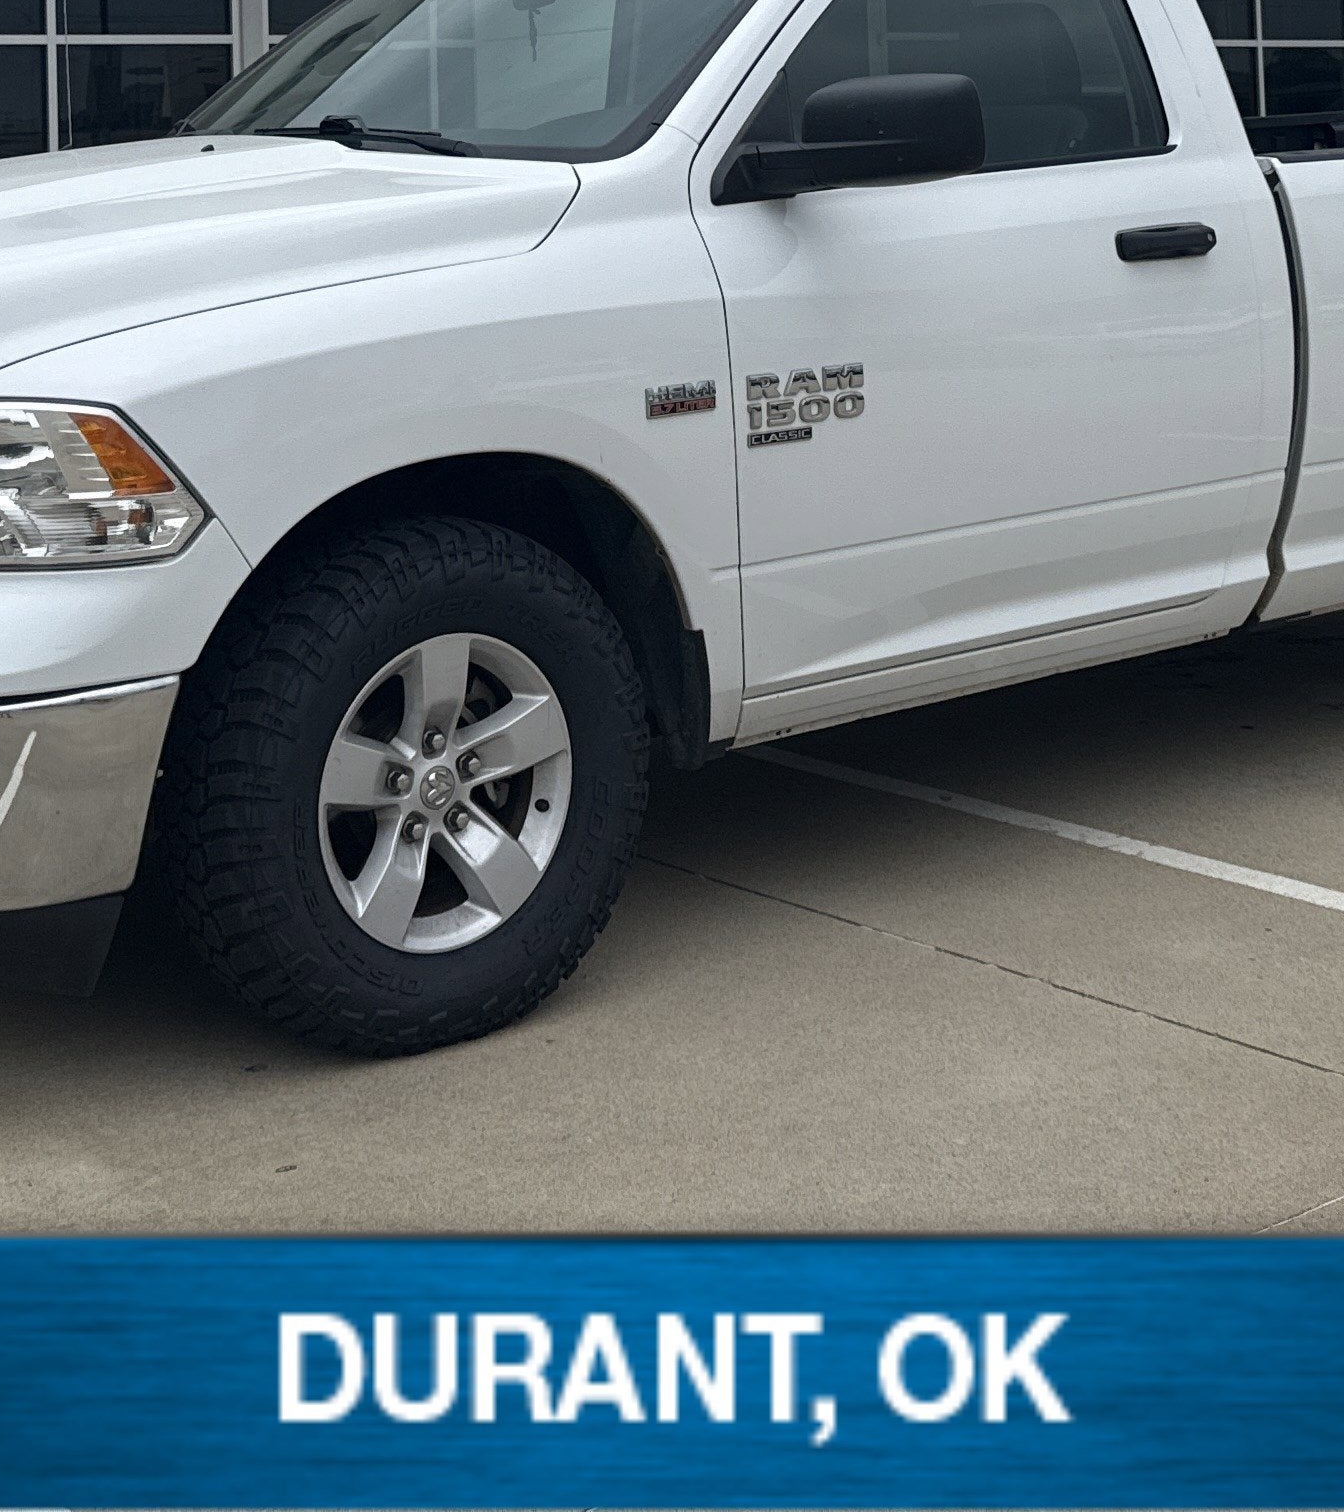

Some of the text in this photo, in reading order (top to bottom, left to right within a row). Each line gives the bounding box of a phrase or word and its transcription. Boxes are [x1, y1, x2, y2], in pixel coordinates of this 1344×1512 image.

[645, 380, 717, 402] HEMI
[745, 362, 865, 401] RAM
[746, 391, 865, 430] 1500
[750, 427, 812, 446] CLASSIC
